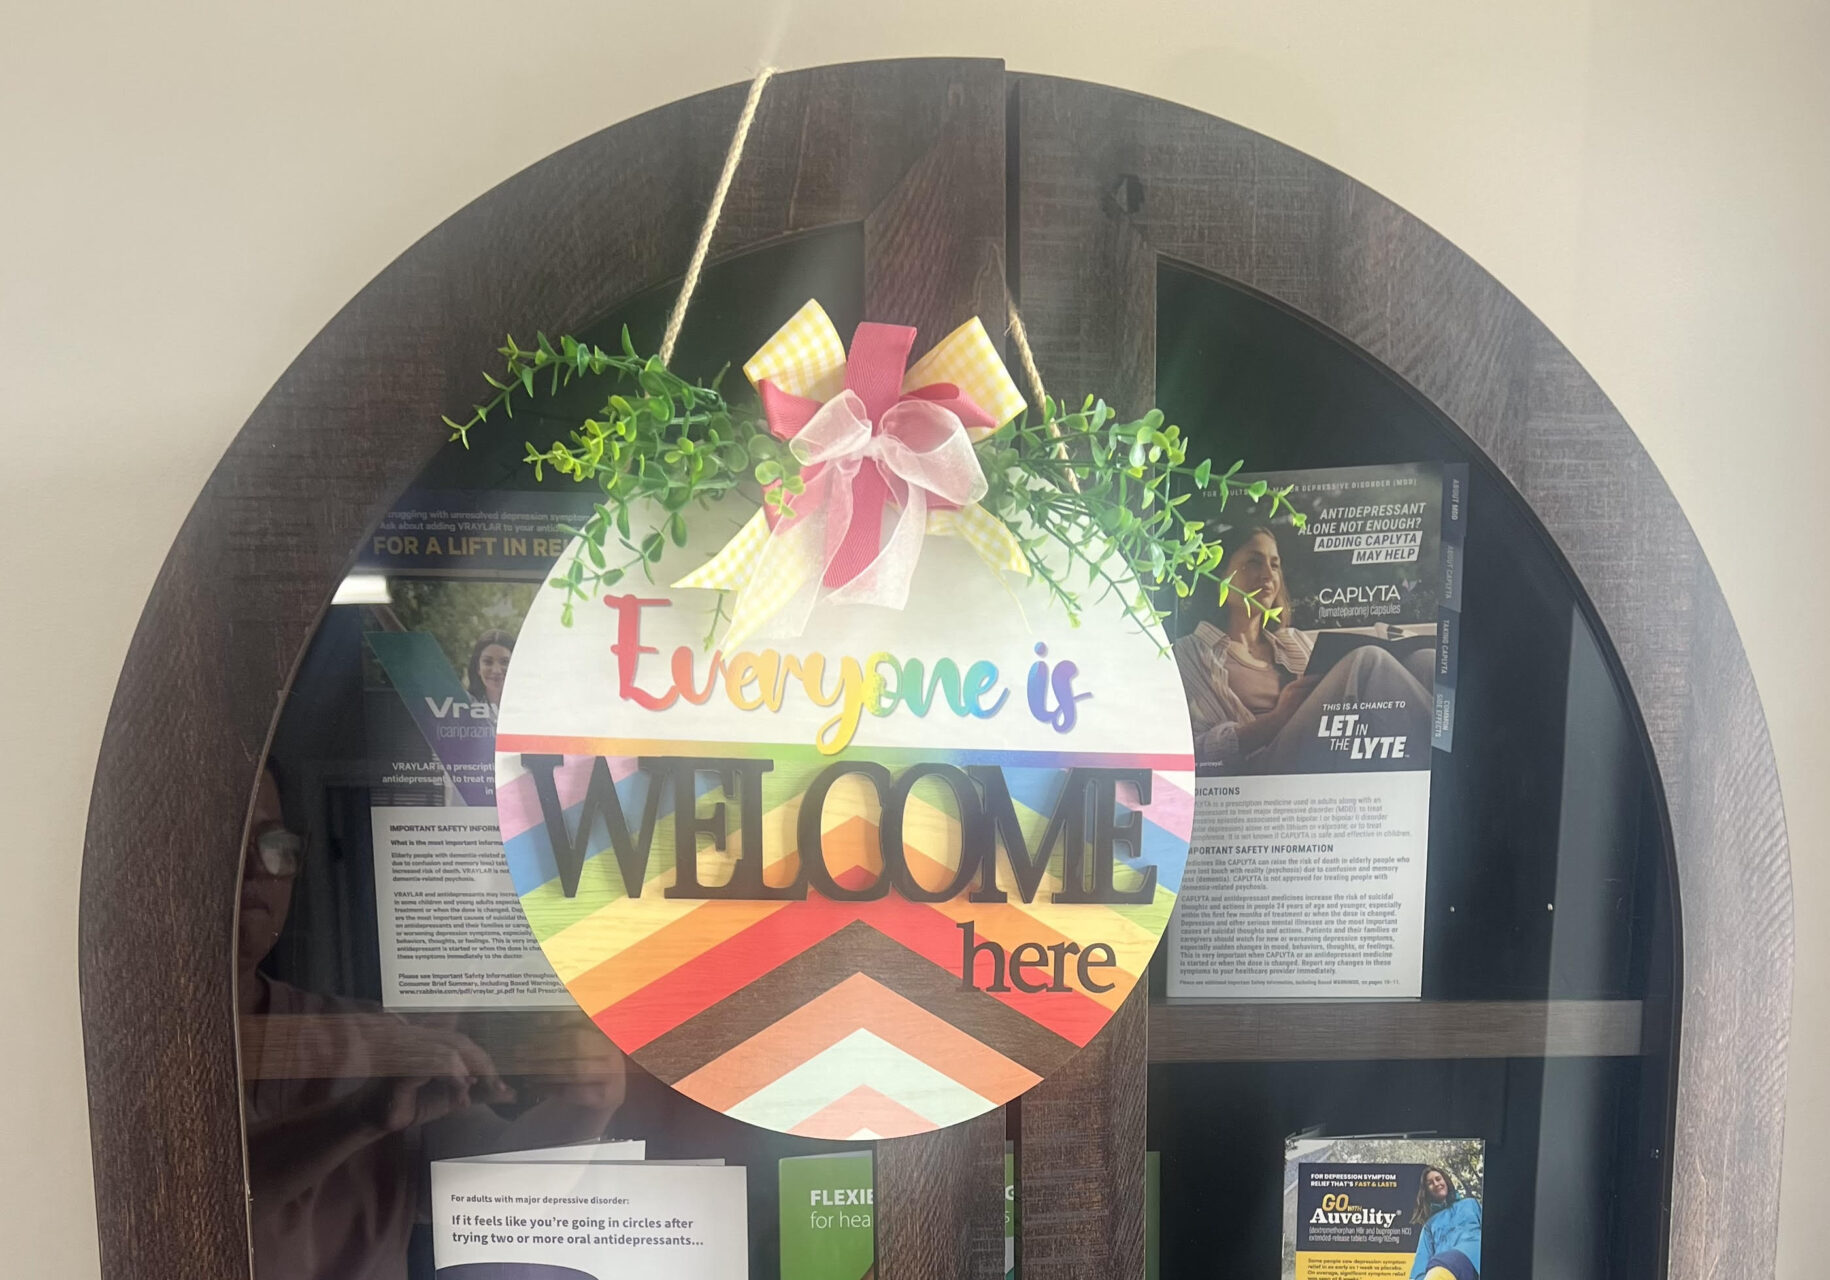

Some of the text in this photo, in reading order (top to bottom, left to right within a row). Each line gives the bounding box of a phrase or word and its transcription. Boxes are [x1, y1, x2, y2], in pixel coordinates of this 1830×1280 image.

[1302, 483, 1349, 492] DEPRESSIVE
[1352, 480, 1390, 488] DISORDER
[1320, 503, 1426, 519] ANTIDEPRESSANT
[1298, 517, 1422, 535] ALONE NOT ENOUGH?
[373, 536, 567, 557] FOR A LIFT IN RE
[1317, 533, 1417, 549] ADDING CAPLYTA
[1356, 549, 1416, 562] MAY HELP
[1319, 584, 1401, 605] CAPLYTA
[1370, 603, 1400, 616] capsules
[603, 594, 1093, 755] Everyone is
[1322, 700, 1406, 711] THIS IS A CHANCE TO
[1318, 715, 1368, 737] LET IN
[1330, 736, 1407, 760] THE LYTE
[1195, 787, 1240, 796] DICATIONS
[520, 754, 1157, 905] WELCOME
[1189, 844, 1333, 855] PORTANT SAFETY INFORMATION
[956, 921, 1116, 994] here
[451, 1194, 630, 1206] For adults with major depressive disorder:
[1322, 1194, 1349, 1211] GO
[452, 1215, 694, 1231] If it feels like you're going in circles after
[810, 1211, 870, 1229] for hea
[1310, 1208, 1397, 1228] Auvelity
[452, 1232, 488, 1245] trying
[490, 1233, 514, 1243] two
[517, 1234, 530, 1244] or
[532, 1235, 564, 1244] more
[567, 1234, 591, 1245] oral
